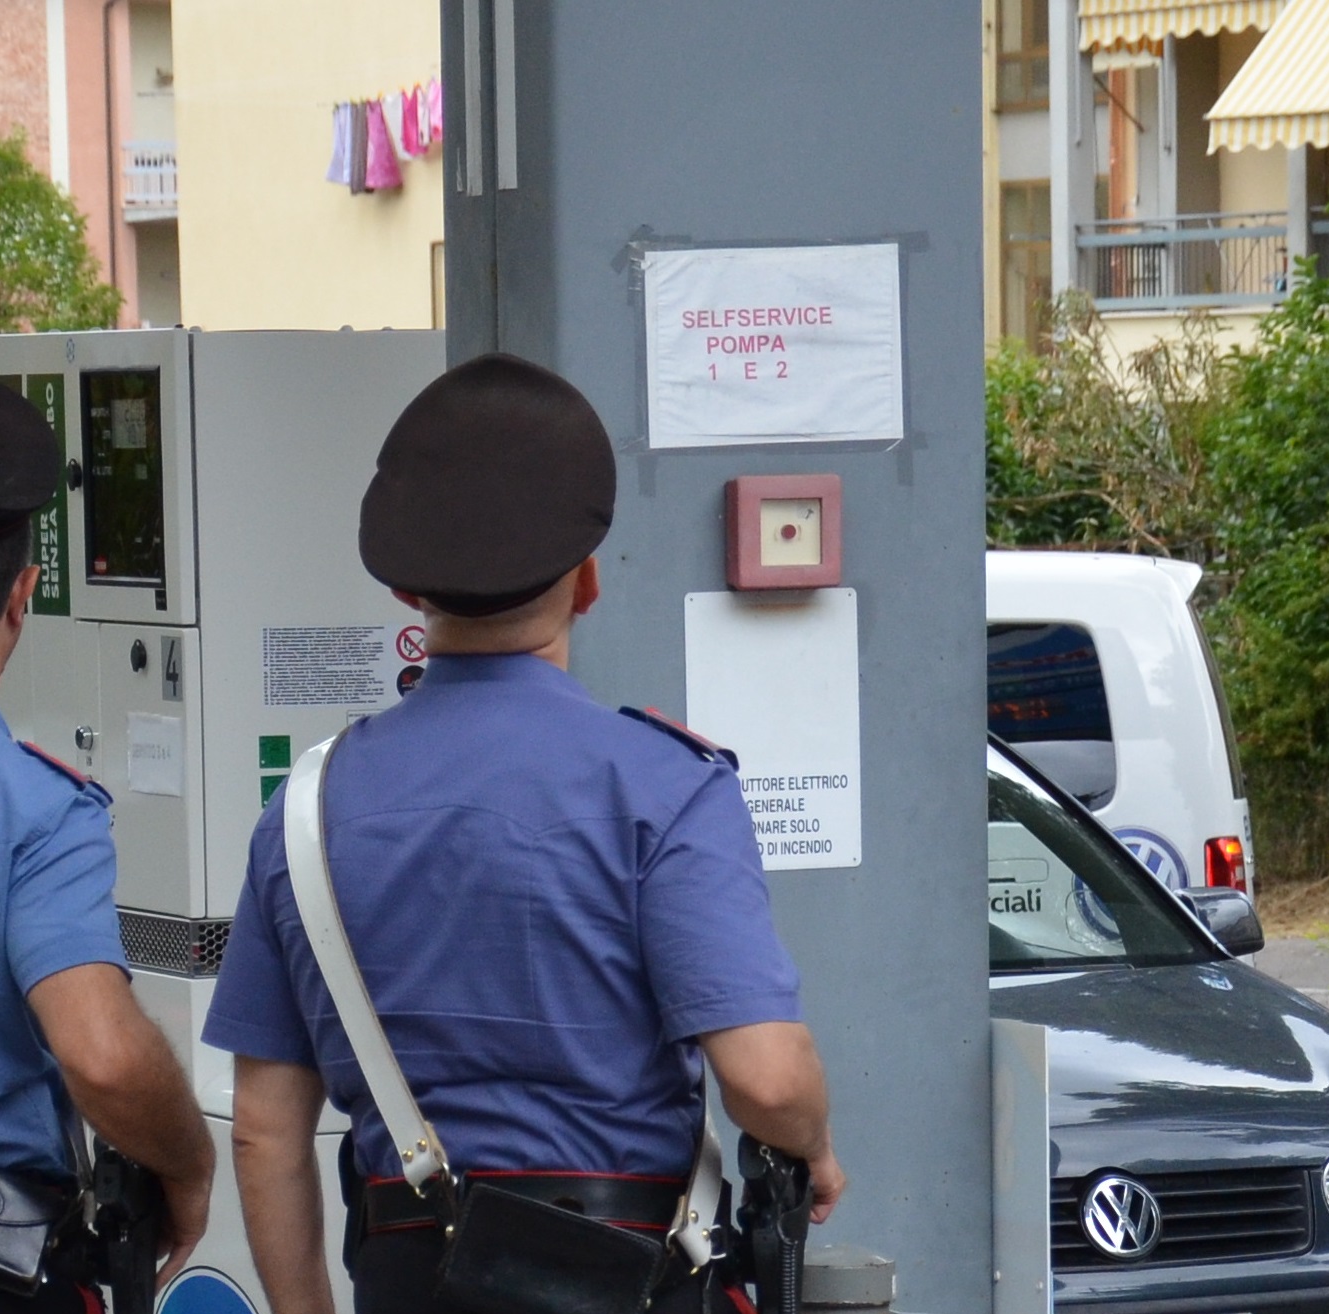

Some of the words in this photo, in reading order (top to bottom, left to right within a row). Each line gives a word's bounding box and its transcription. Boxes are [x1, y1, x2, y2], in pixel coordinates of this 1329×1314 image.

[682, 306, 833, 329] SELFSERVICE
[707, 335, 786, 355] POMPA
[708, 363, 717, 381] 1
[744, 362, 758, 380] E
[776, 361, 788, 379] 2
[40, 513, 50, 598] SUPER
[48, 508, 59, 598] SENZA
[165, 639, 179, 697] 4
[741, 777, 785, 792] UTTORE
[788, 775, 848, 790] ELETTRICO
[746, 798, 805, 813] GENERALE
[752, 819, 787, 835] ONARE
[790, 818, 820, 833] SOLO
[767, 842, 777, 855] DI
[780, 839, 833, 855] INCENDIO
[989, 888, 1042, 914] ciali
